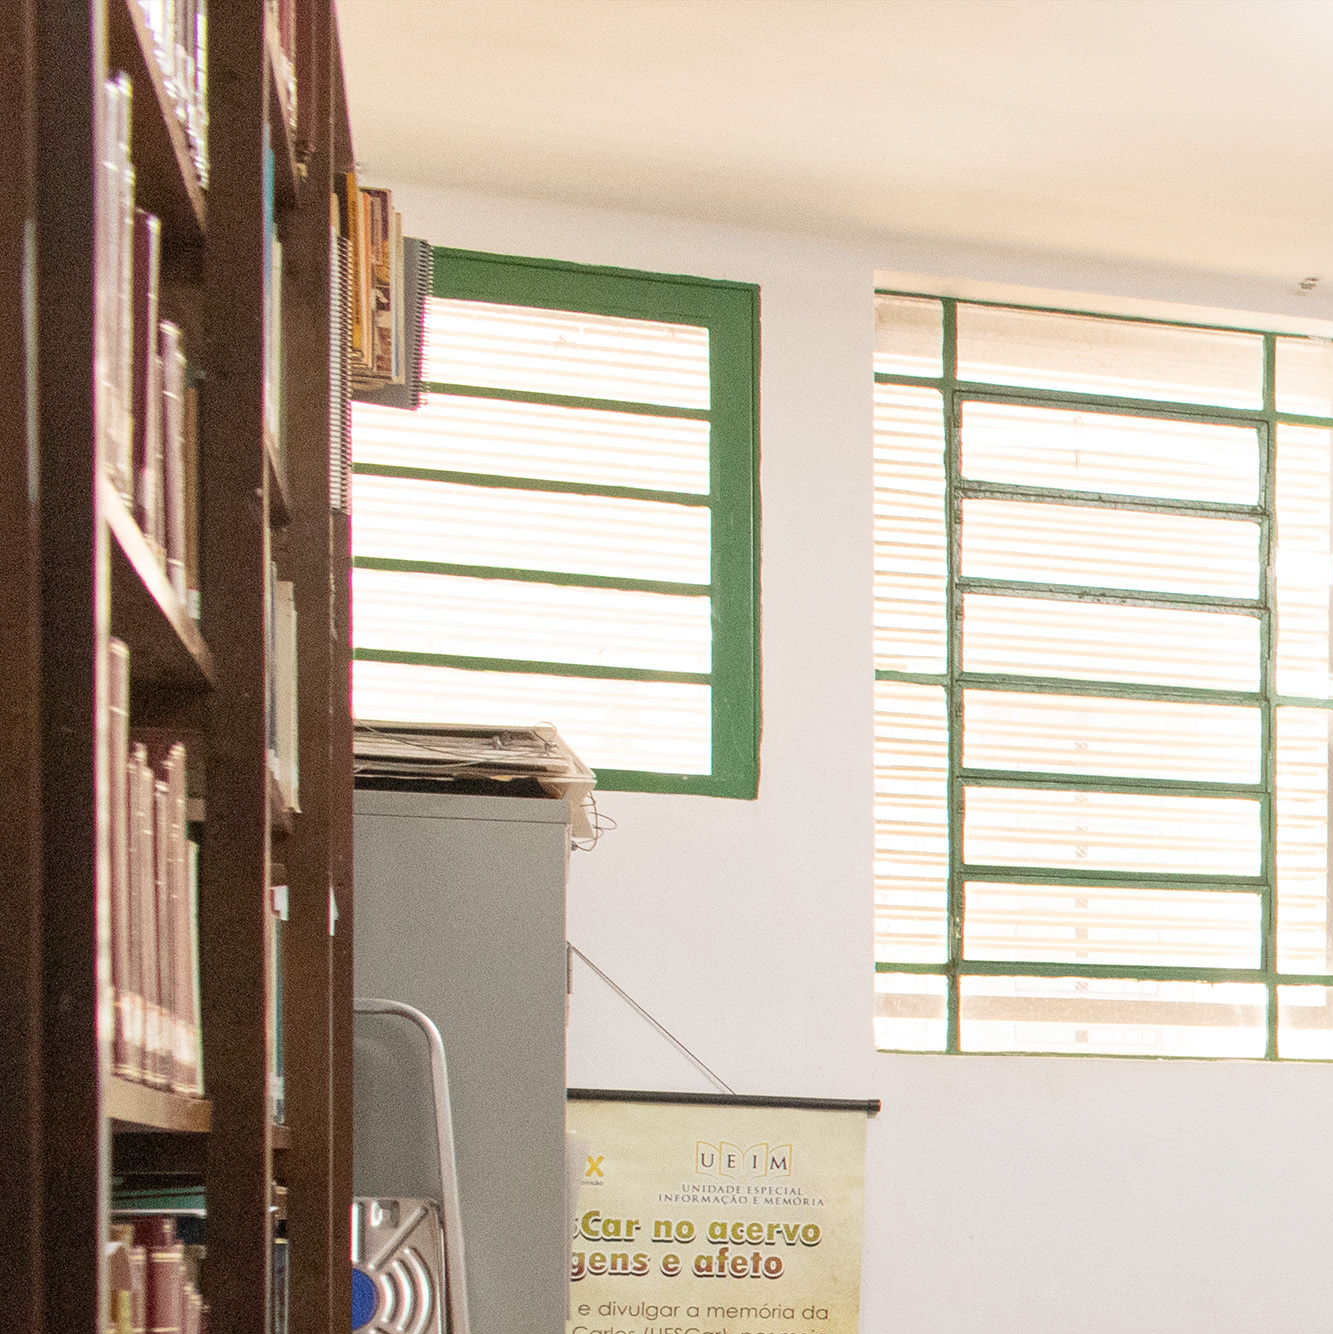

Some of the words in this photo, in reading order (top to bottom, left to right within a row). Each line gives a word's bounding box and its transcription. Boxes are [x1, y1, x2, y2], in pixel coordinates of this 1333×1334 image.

[658, 1194, 748, 1206] INFORMAÇÃO
[753, 1196, 759, 1205] E
[682, 1184, 743, 1195] UNIDADE
[747, 1186, 803, 1196] ESPECIAL
[652, 1216, 696, 1241] no
[707, 1219, 822, 1245] acervo
[570, 1250, 651, 1279] gens
[660, 1252, 682, 1275] e
[693, 1246, 785, 1278] afeto
[578, 1303, 590, 1316] e
[598, 1301, 681, 1322] divulgar
[686, 1306, 700, 1318] a
[707, 1301, 795, 1321] memória
[801, 1303, 829, 1321] da
